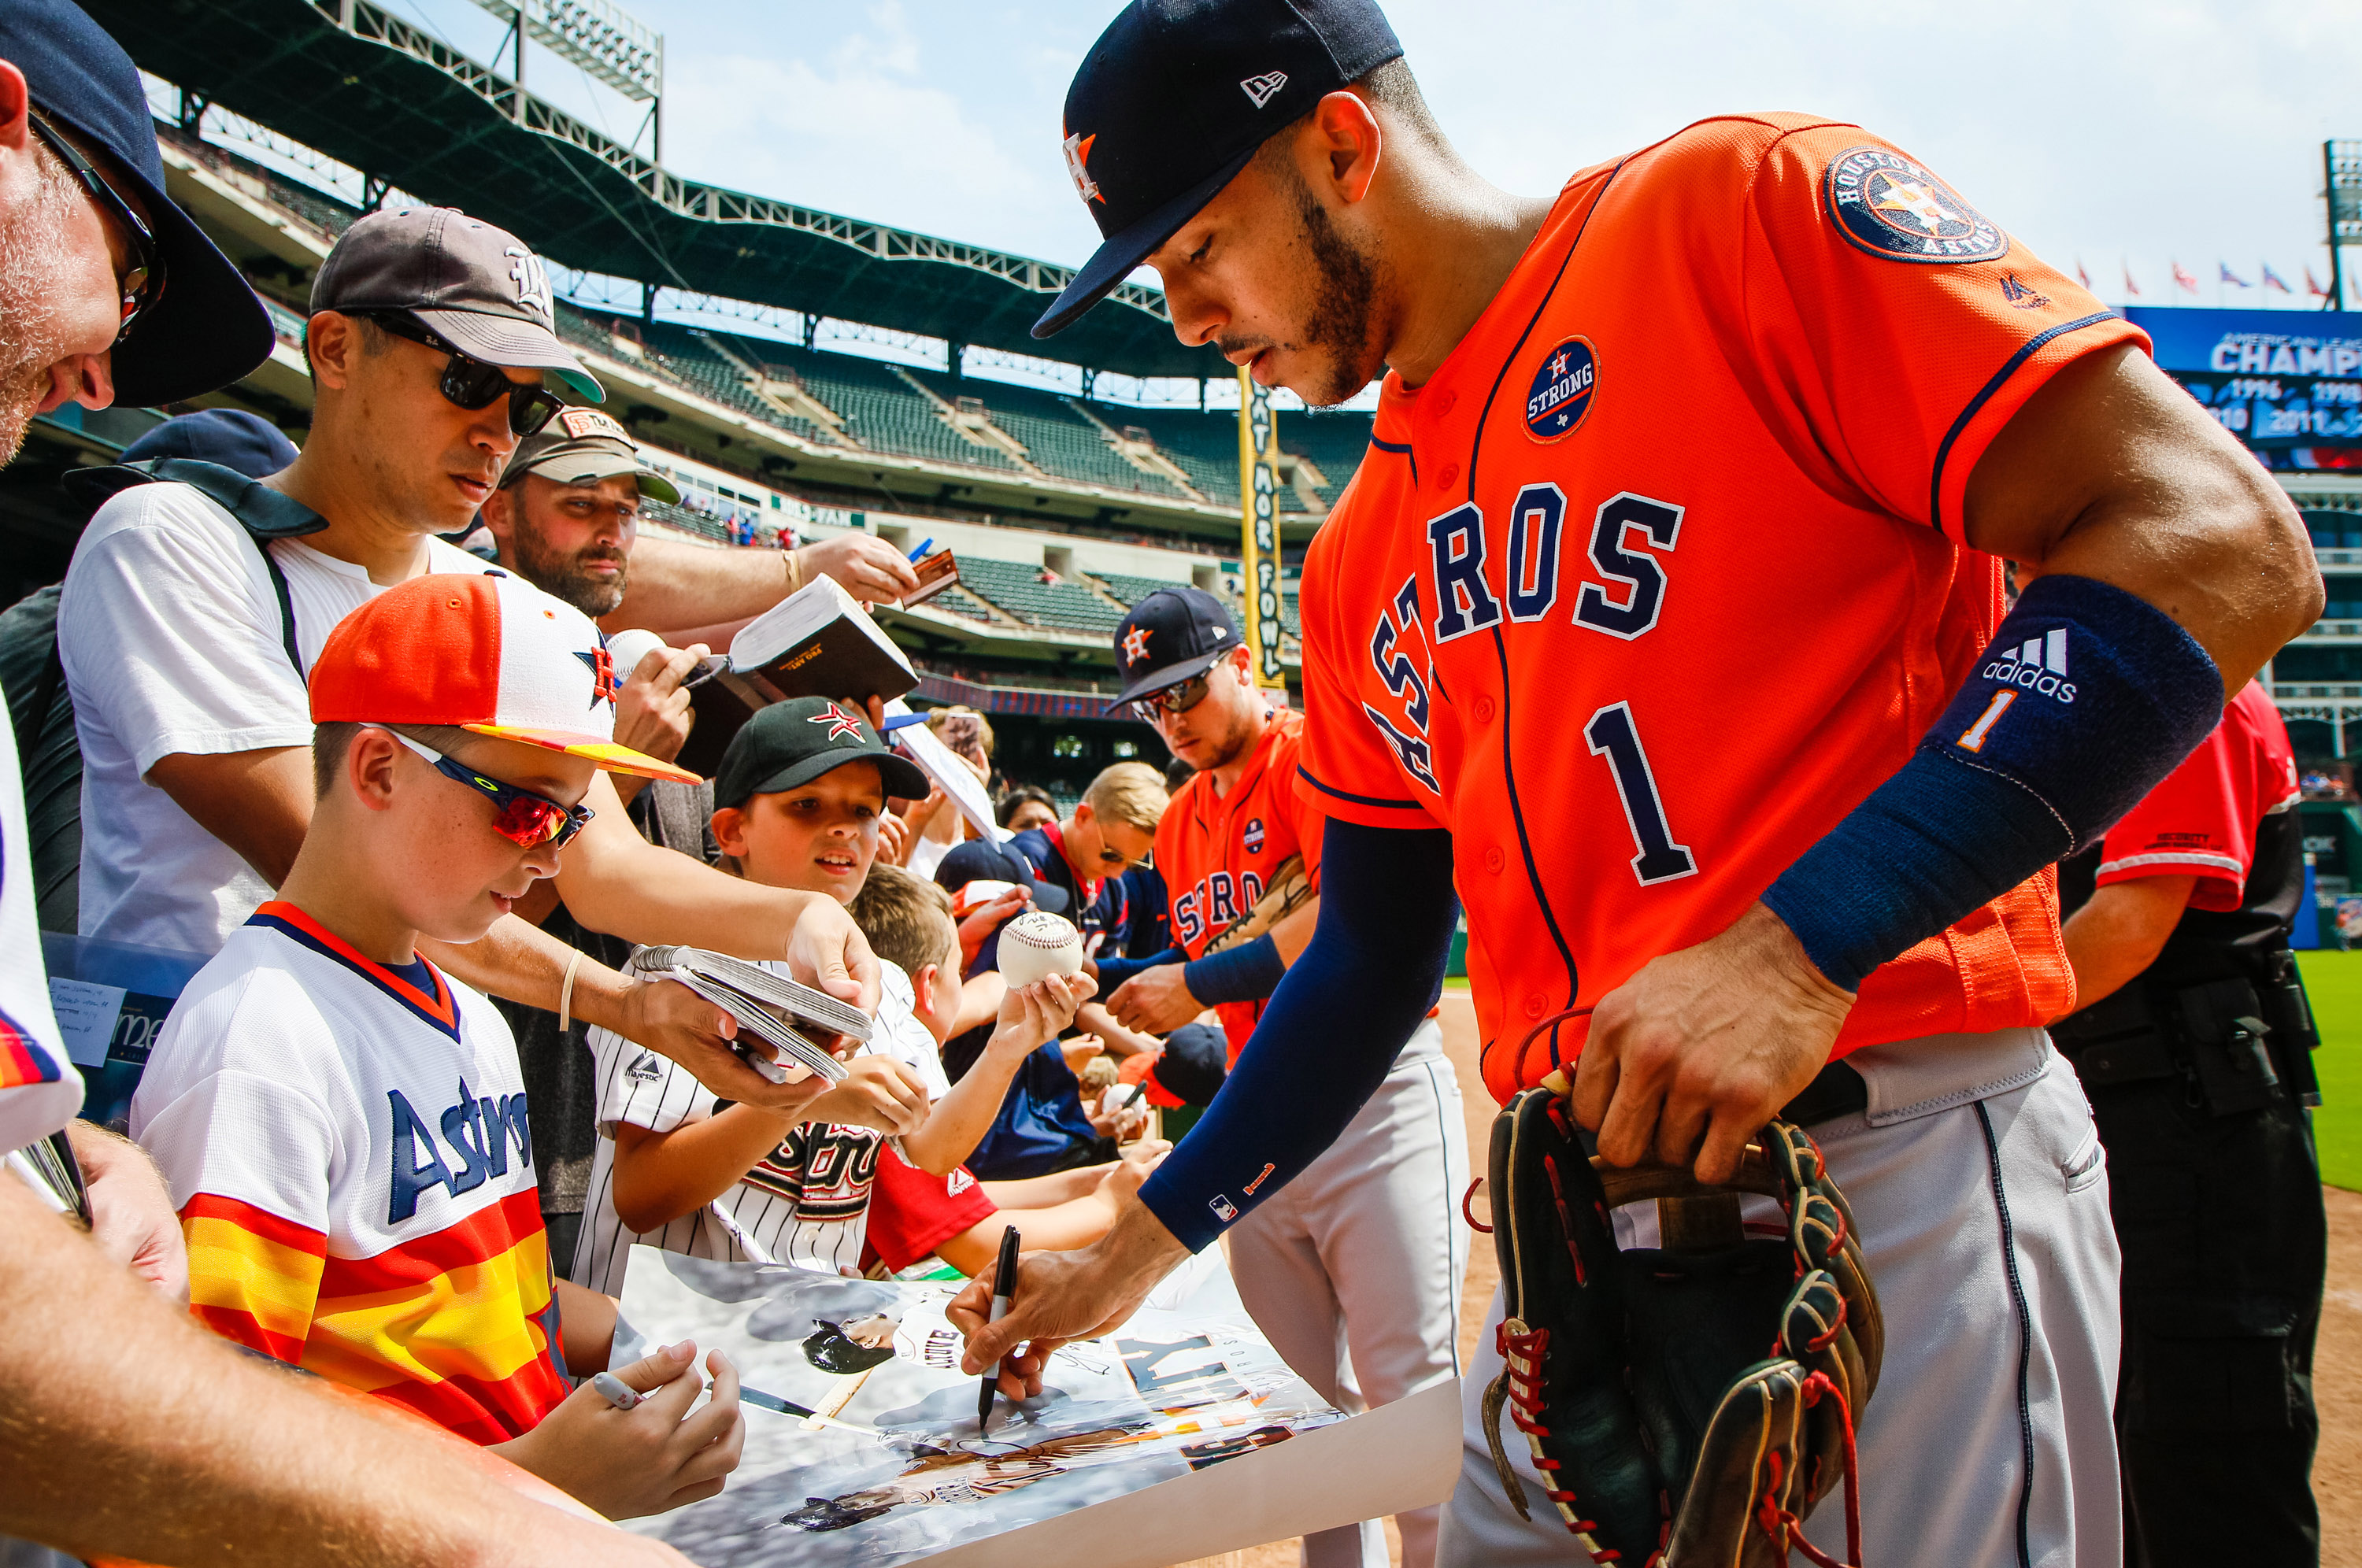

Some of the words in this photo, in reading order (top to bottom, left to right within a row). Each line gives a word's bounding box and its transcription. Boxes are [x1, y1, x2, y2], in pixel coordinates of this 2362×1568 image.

[1836, 153, 1922, 205] HOUSTON
[1922, 221, 1995, 254] ASTROS
[1527, 362, 1593, 419] STRONG
[2230, 378, 2282, 400] 1996
[2209, 406, 2249, 431] 10
[2268, 408, 2324, 433] 2011
[1255, 464, 1274, 550] MOR
[1258, 563, 1279, 676] FOWL
[1983, 660, 2078, 703] adidas
[1956, 689, 2019, 753] 1
[1583, 700, 1698, 887] 1
[625, 1067, 659, 1082] Majestic
[1243, 1163, 1275, 1196] 1
